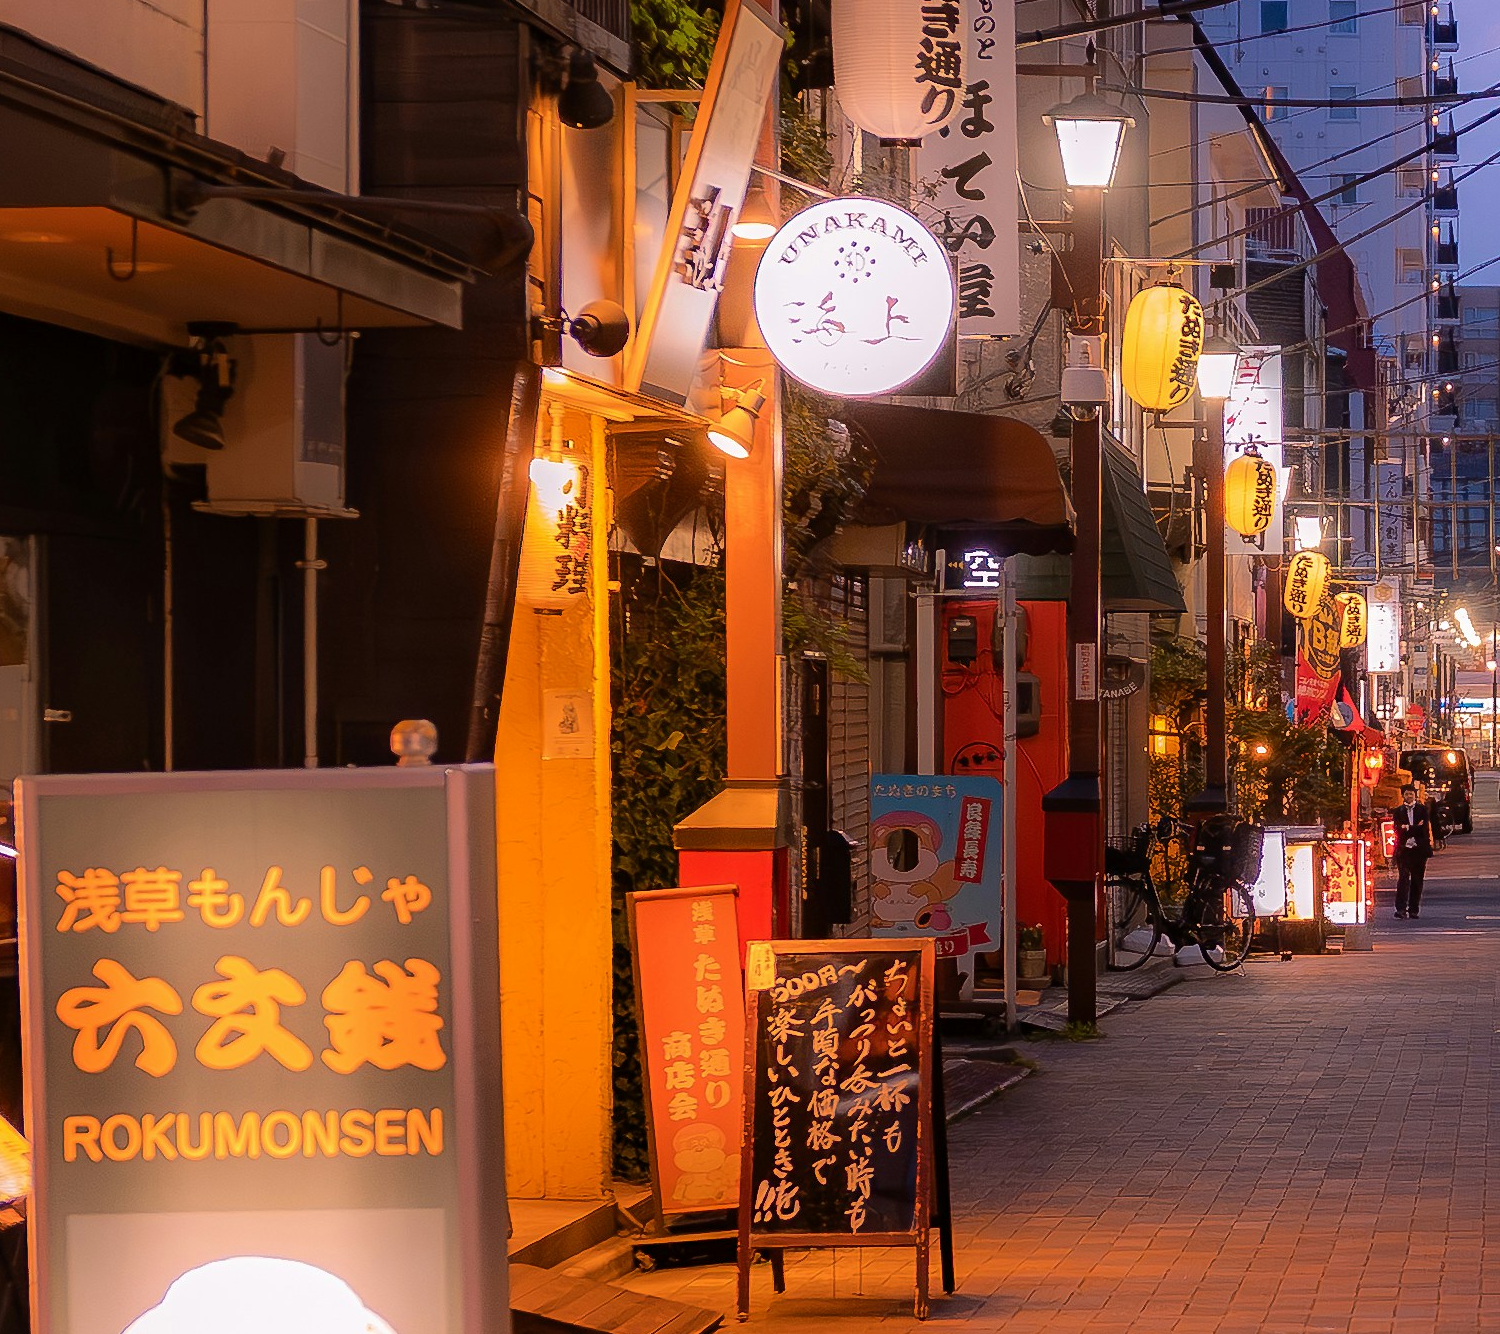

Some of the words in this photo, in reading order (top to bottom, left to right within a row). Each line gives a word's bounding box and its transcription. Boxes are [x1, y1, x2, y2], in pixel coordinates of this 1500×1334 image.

[778, 212, 929, 268] UNAKAMI
[1169, 294, 1204, 405] たぬき通り
[1252, 458, 1275, 531] たぬき通り
[963, 549, 1001, 588] 空
[1288, 555, 1313, 615] たぬき通り
[1346, 594, 1363, 646] たぬき通り
[873, 783, 957, 799] たぬきのまち
[55, 866, 433, 934] 浅草もんじゃ
[691, 901, 717, 945] 浅草
[55, 955, 448, 1078] 六文銭
[693, 954, 732, 1110] たぬき通り
[661, 1030, 699, 1122] 商店会
[873, 958, 914, 1153] ちょいと一杯も
[806, 997, 843, 1185] 手頃な価格で
[62, 1107, 444, 1163] ROKUMONSEN
